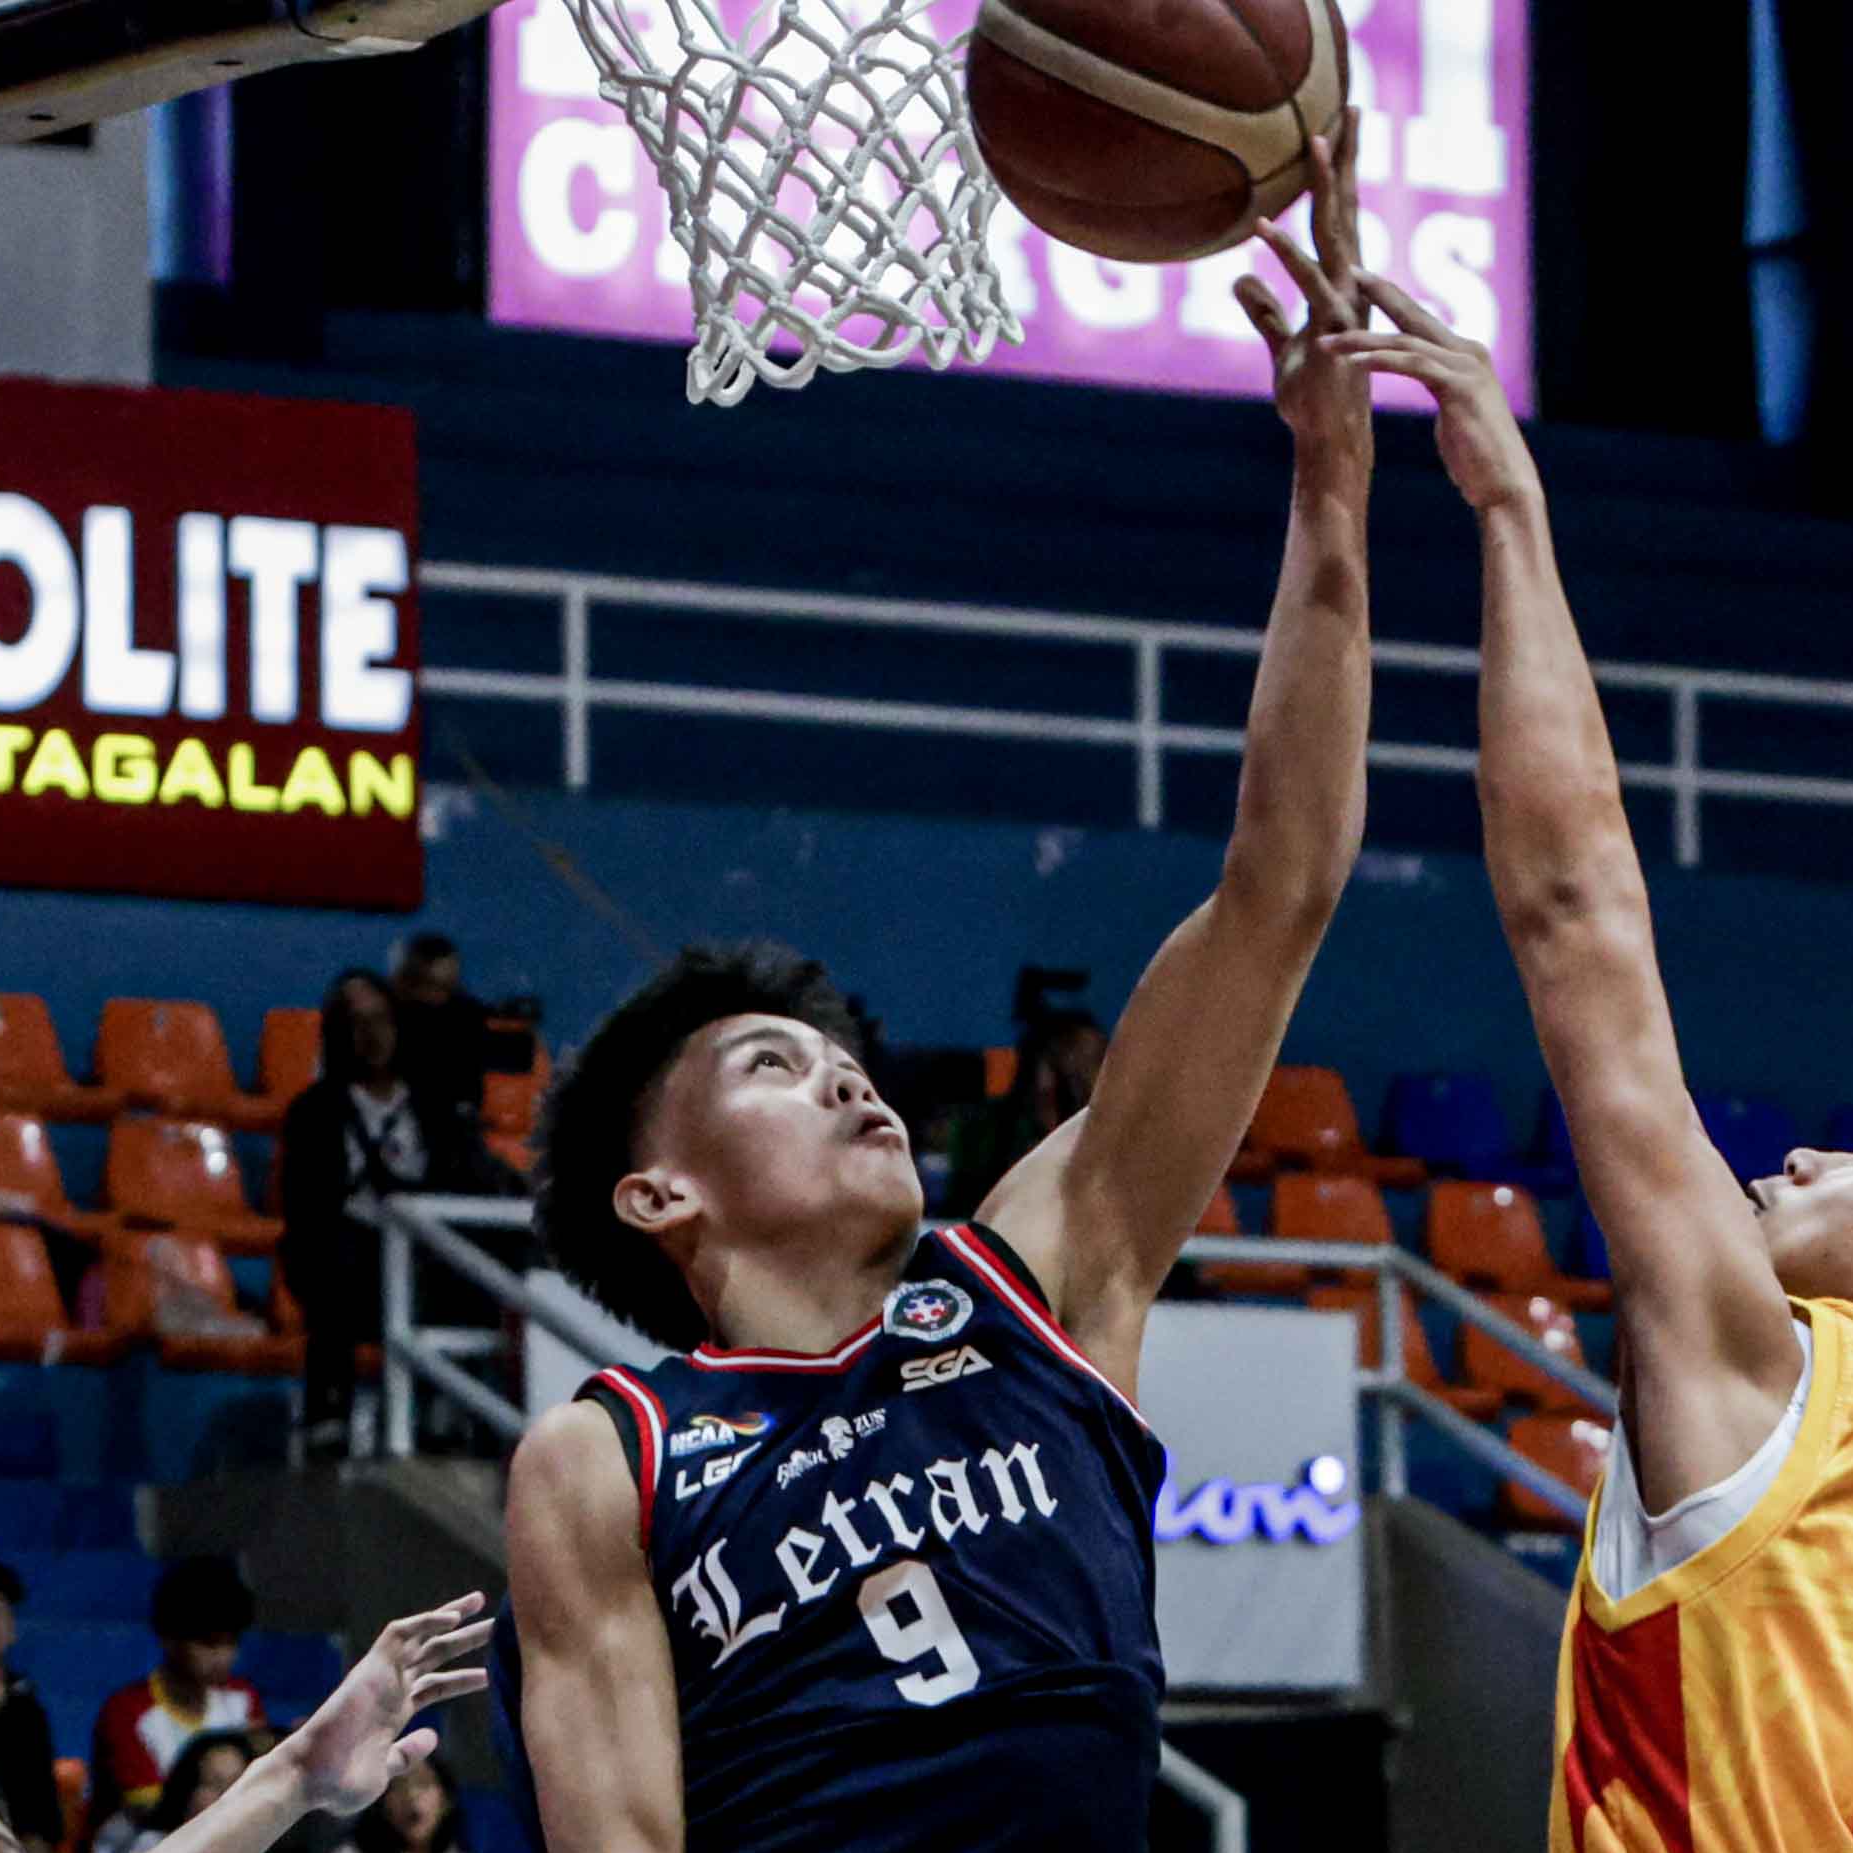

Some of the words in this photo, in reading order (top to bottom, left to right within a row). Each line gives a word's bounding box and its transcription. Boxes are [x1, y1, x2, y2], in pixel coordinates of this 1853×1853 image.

[900, 1344, 993, 1392] SGA
[670, 1422, 736, 1457] NCAA
[671, 1440, 1058, 1669] Letran
[857, 1560, 981, 1707] 9
